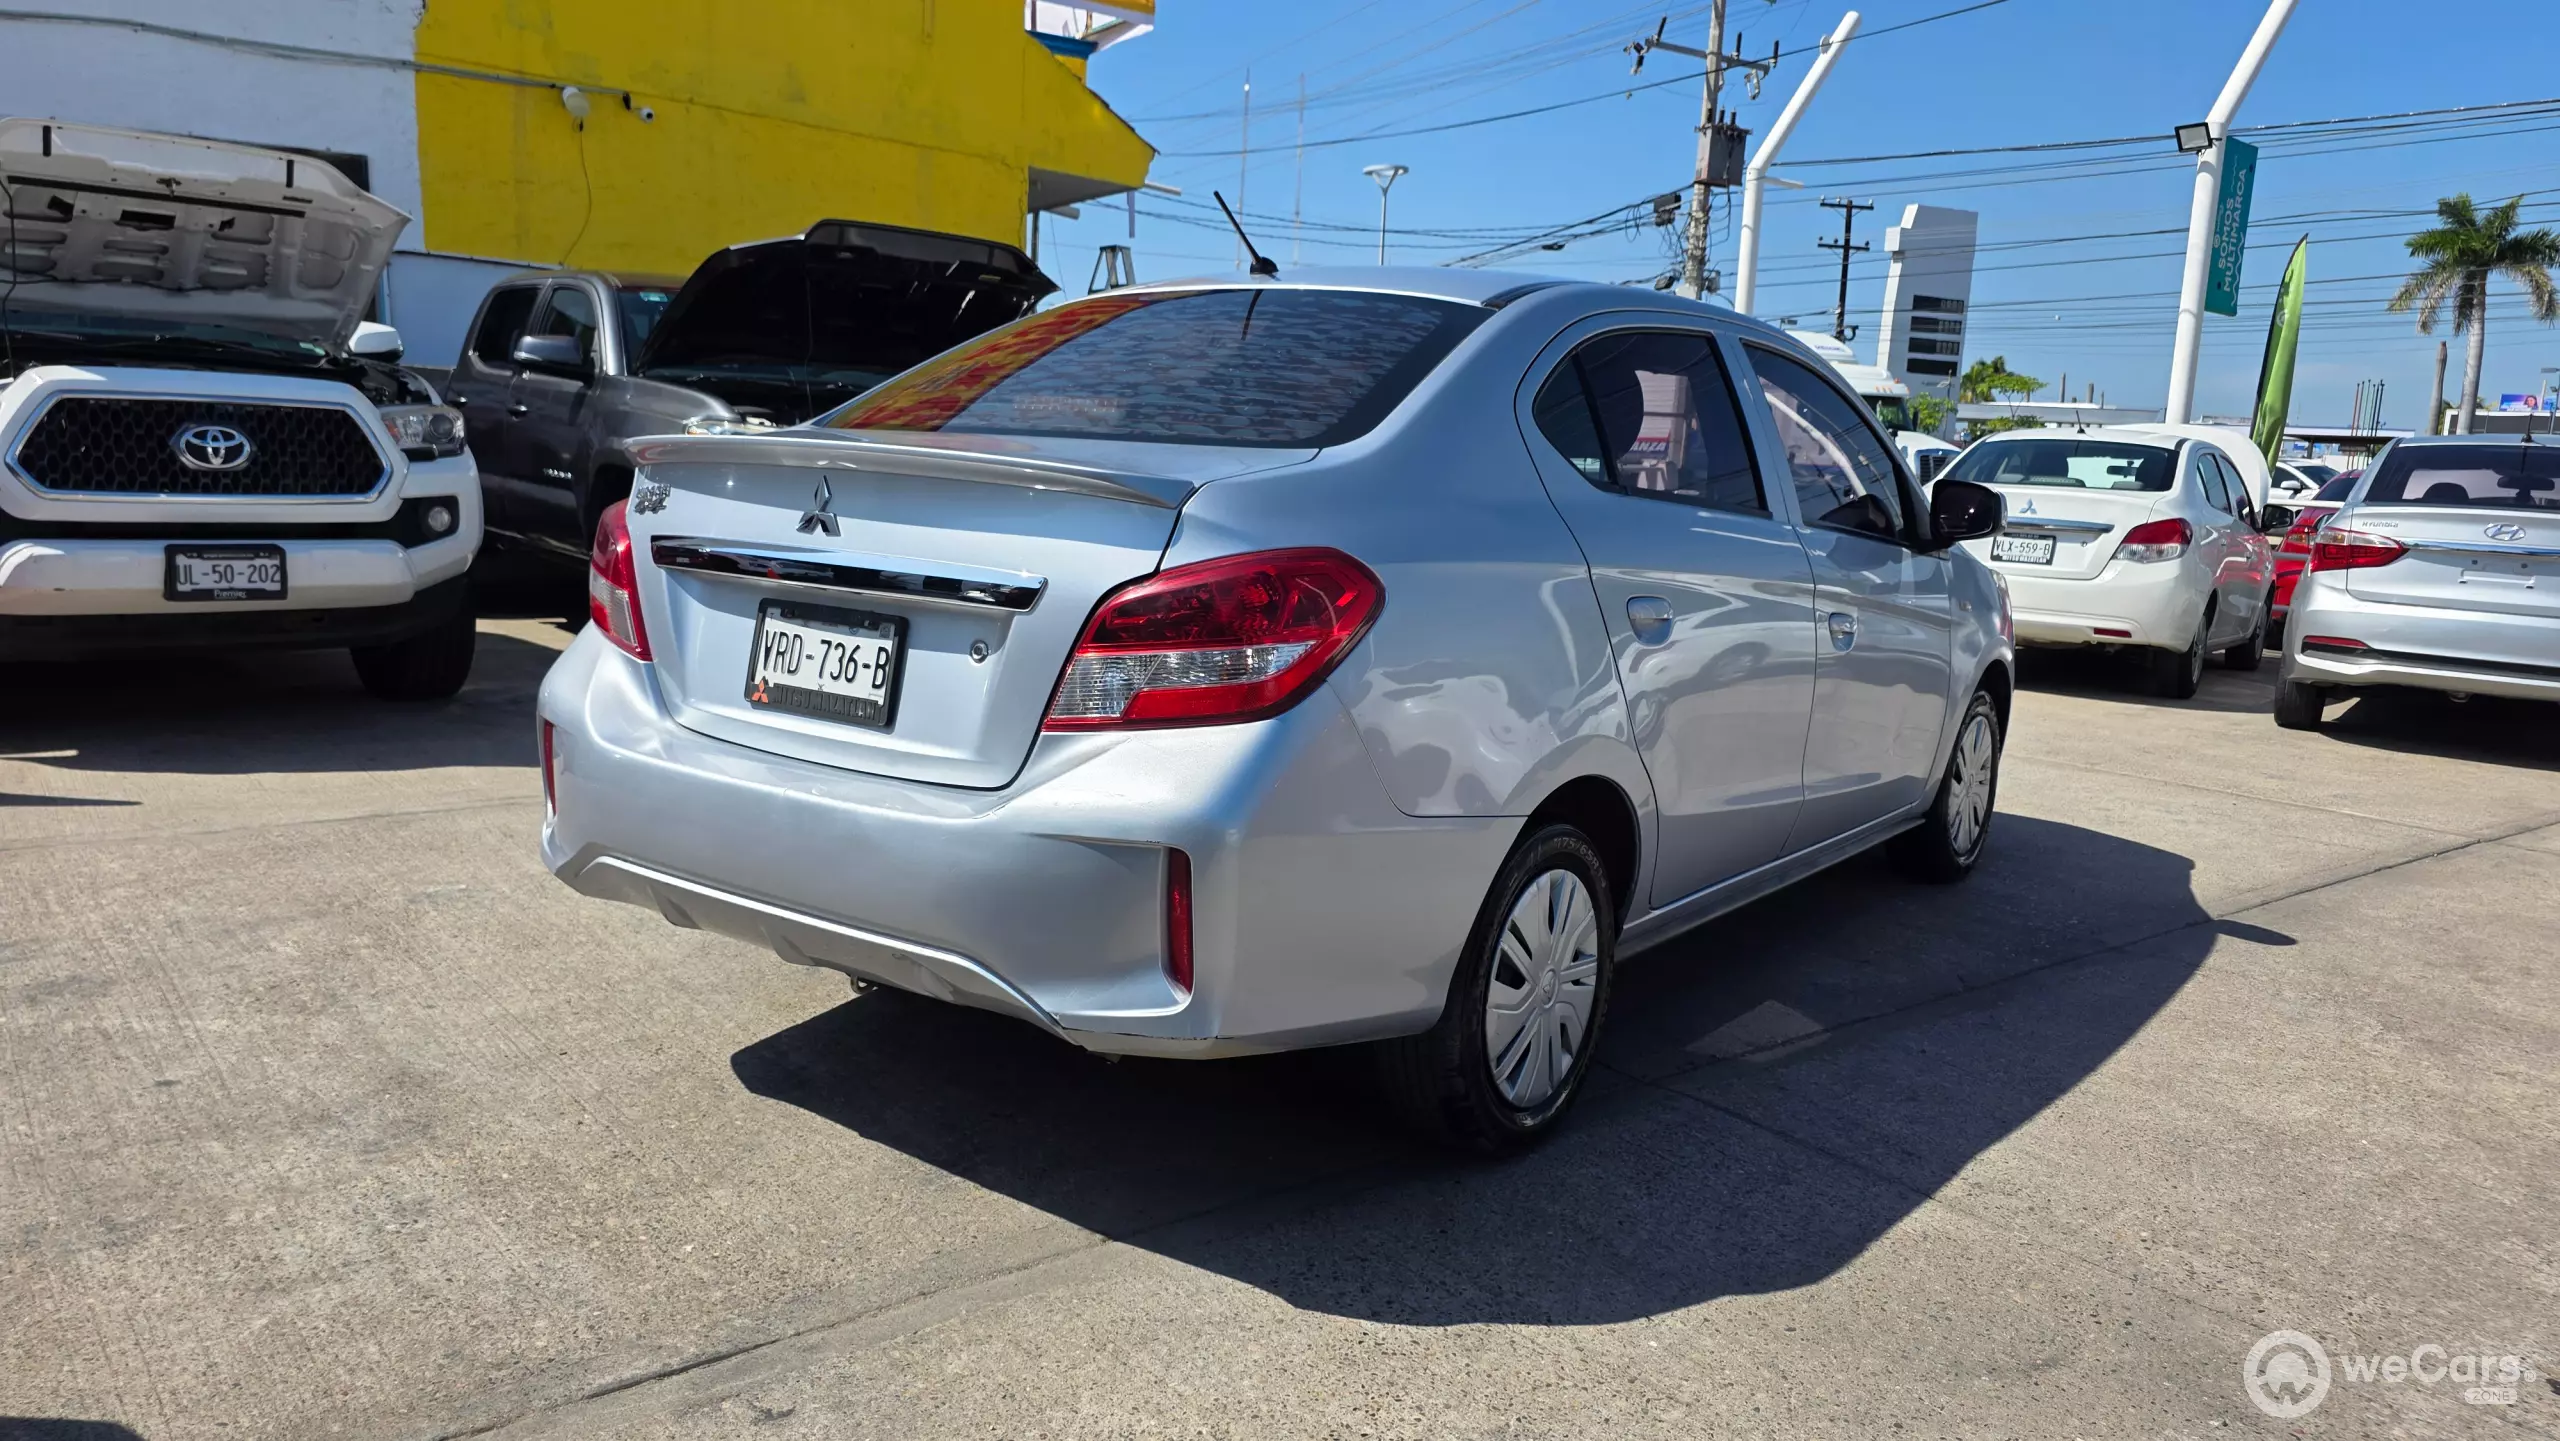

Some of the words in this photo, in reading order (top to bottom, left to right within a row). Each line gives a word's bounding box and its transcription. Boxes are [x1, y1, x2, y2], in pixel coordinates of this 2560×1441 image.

[2218, 198, 2234, 269] SOMOS
[2223, 168, 2247, 292] MULTIMARCA
[1996, 540, 2051, 556] VLX-559-B
[177, 563, 281, 585] UL-50-202
[214, 589, 247, 599] Premier
[763, 629, 891, 690] VRD-736-B
